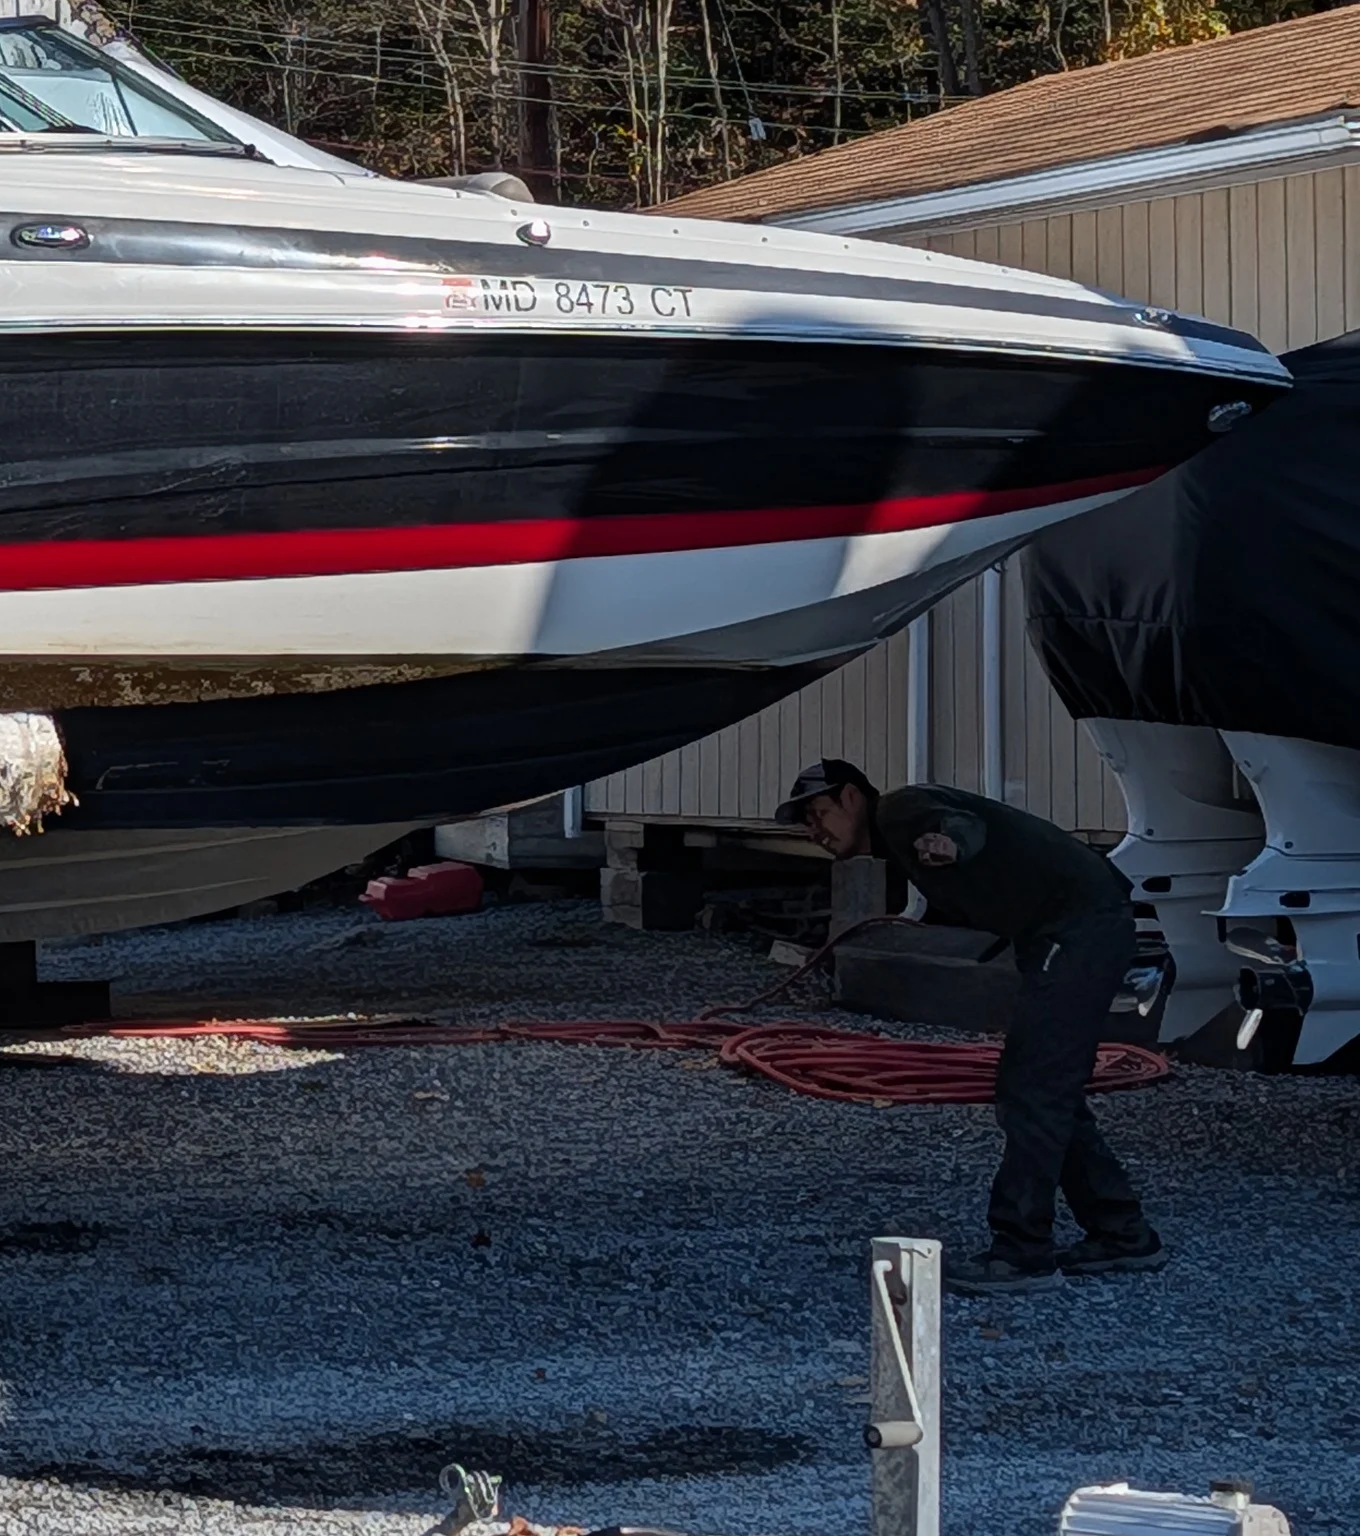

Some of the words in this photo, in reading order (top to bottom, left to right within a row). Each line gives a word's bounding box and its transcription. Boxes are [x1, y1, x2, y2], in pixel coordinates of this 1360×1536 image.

[481, 279, 537, 312] MD
[555, 283, 634, 315] 8473
[651, 287, 693, 317] CT
